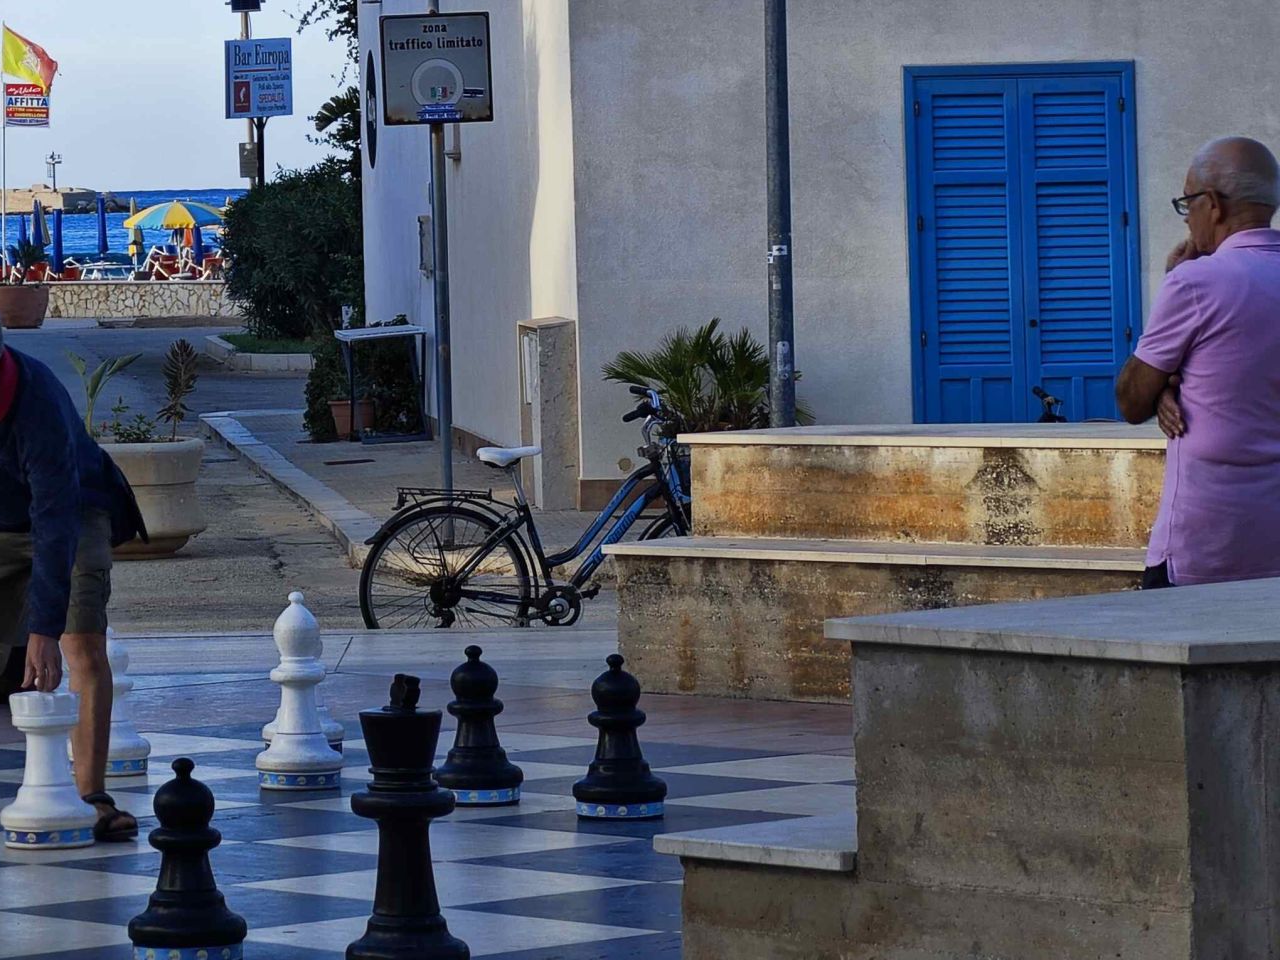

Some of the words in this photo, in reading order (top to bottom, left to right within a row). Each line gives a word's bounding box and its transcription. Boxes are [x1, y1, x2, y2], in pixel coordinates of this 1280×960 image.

[423, 24, 447, 33] zona
[389, 38, 433, 51] traffico
[437, 36, 483, 49] limitato
[234, 45, 252, 66] Bar
[255, 44, 290, 70] Europa
[7, 97, 49, 107] AFFITTA
